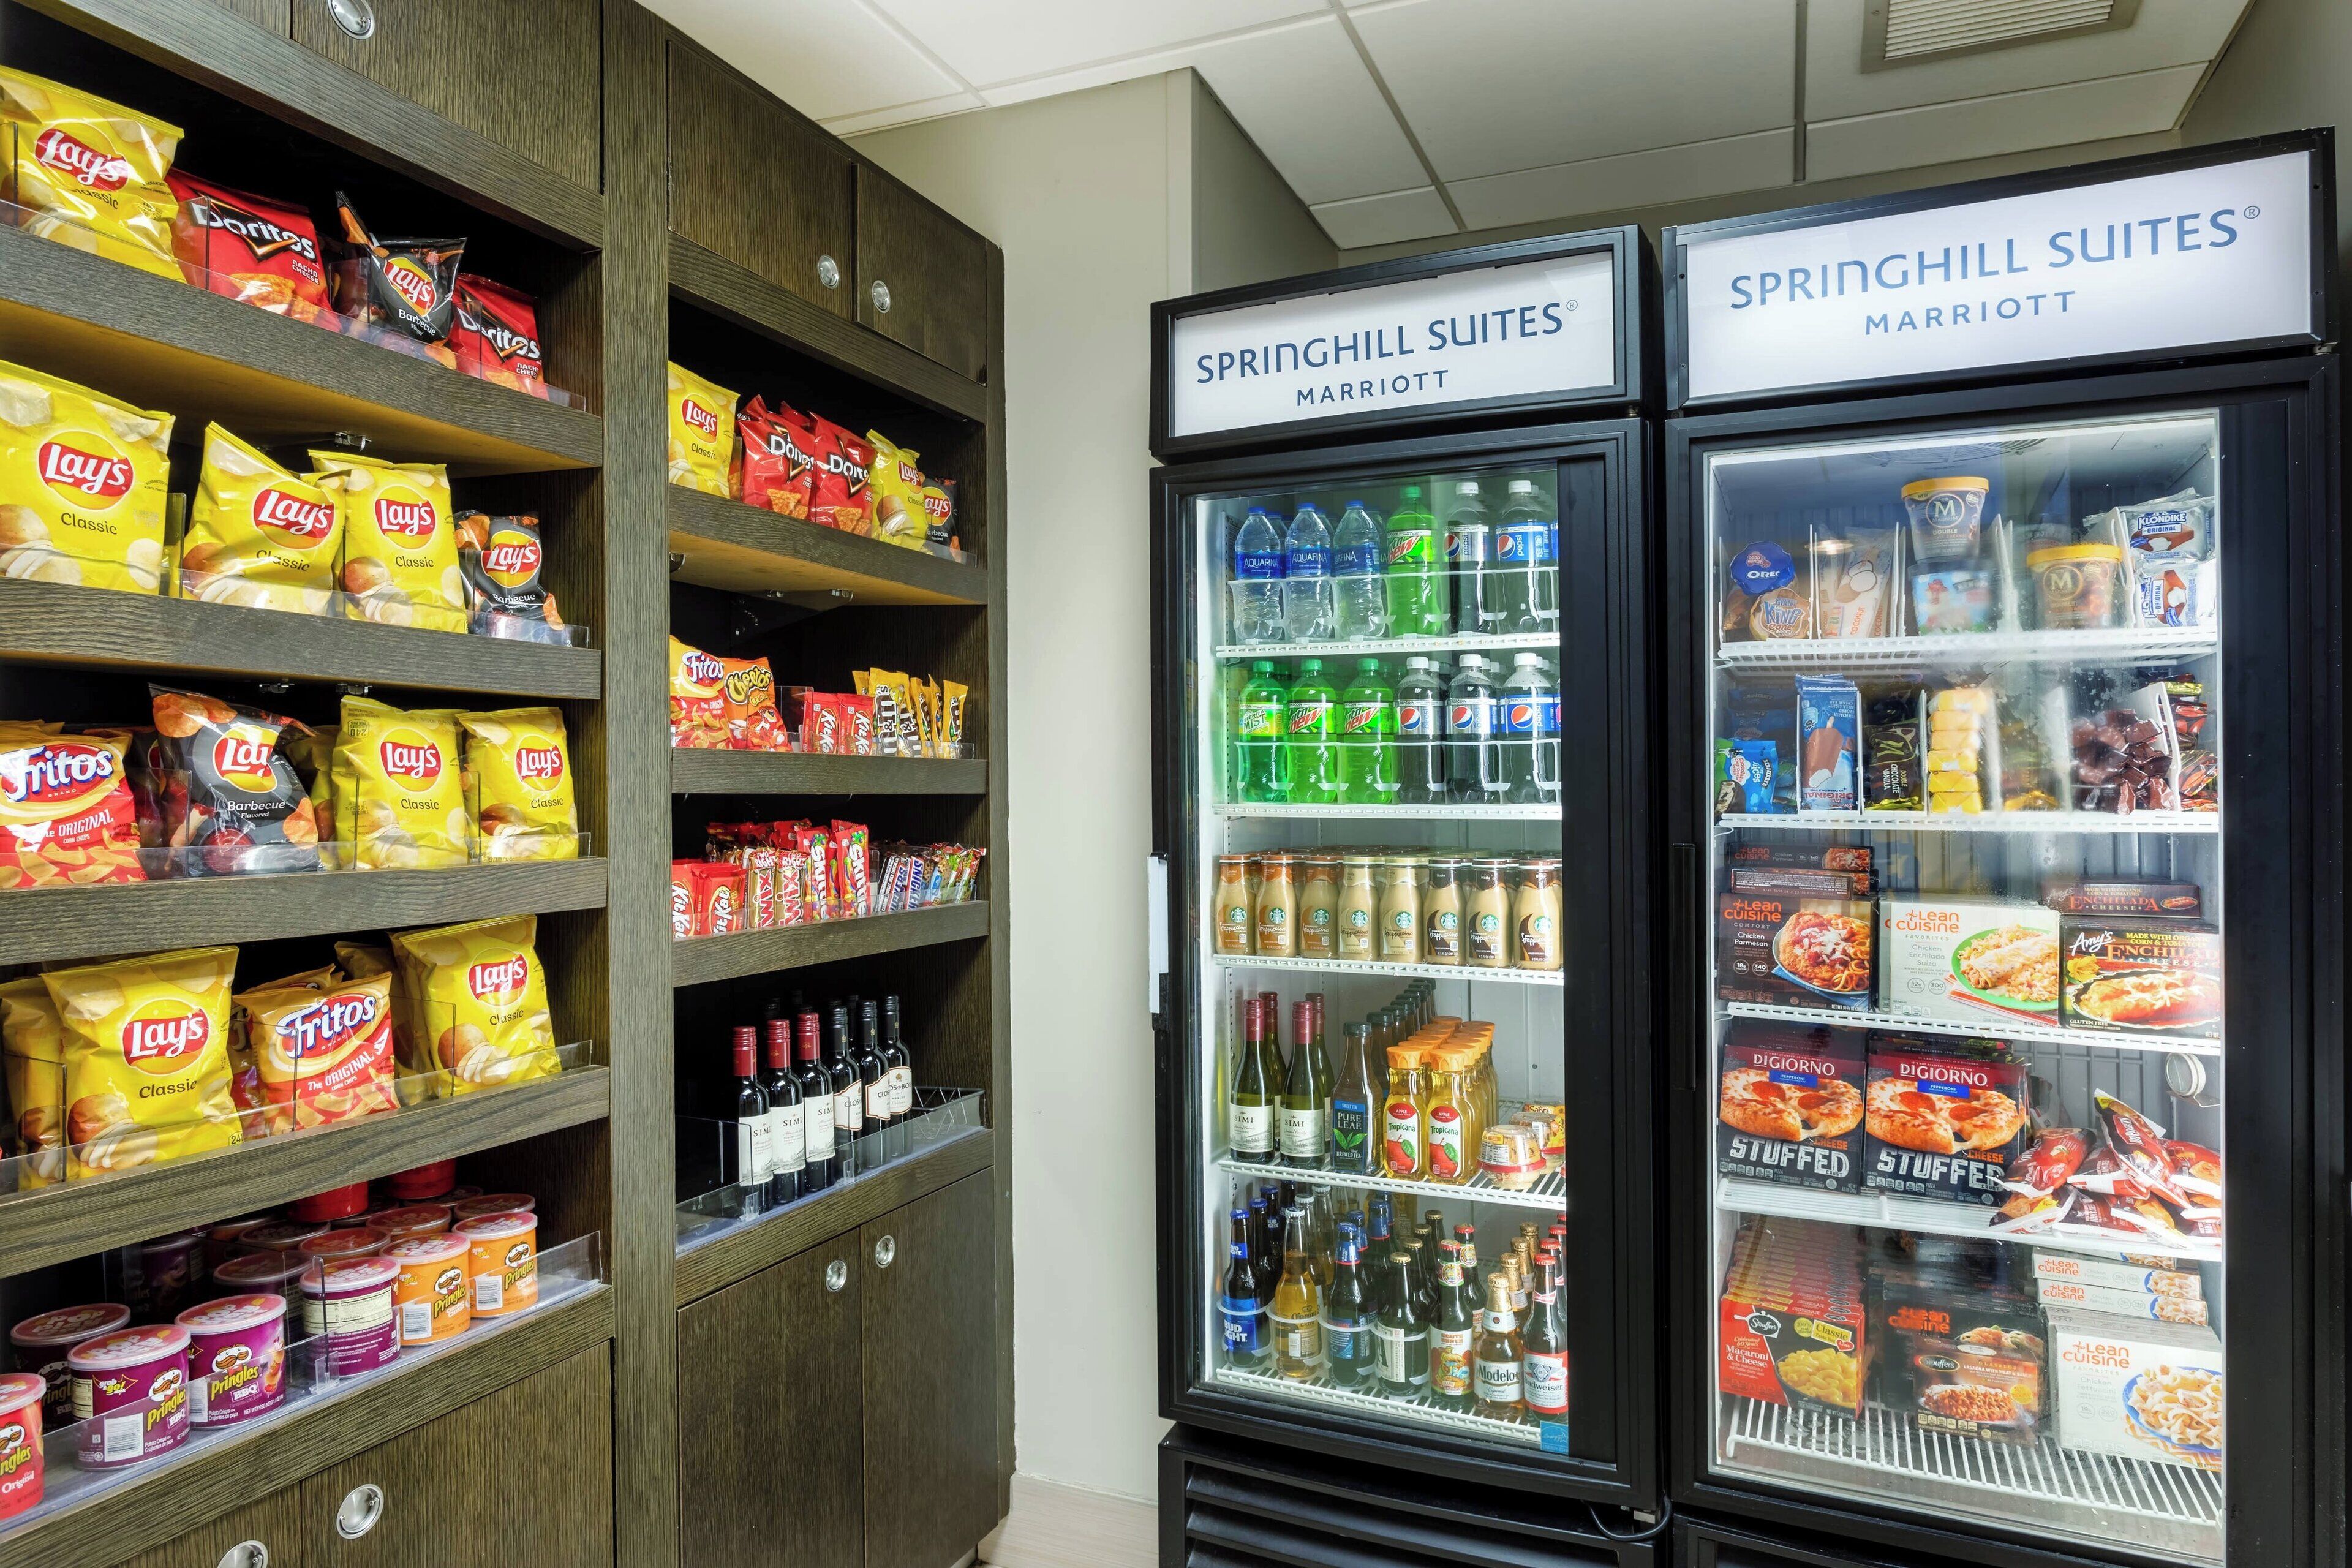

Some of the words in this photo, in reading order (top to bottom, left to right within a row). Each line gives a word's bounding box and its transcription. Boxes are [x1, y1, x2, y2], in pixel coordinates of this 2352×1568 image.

[40, 131, 121, 186] Lay's
[191, 201, 317, 262] Doritos
[292, 258, 318, 278] NACHO
[1730, 238, 2029, 309] SPRINGHILL
[2049, 208, 2239, 268] SUITES
[292, 265, 320, 285] CHEESE
[387, 265, 431, 304] Lay's
[1865, 290, 2076, 335] MARRIOTT
[399, 309, 436, 336] Barbecue
[1197, 325, 1414, 384] SPRINGHILL
[1428, 303, 1563, 351] SUITES
[1297, 369, 1449, 406] MARRIOTT
[685, 401, 717, 432] Lay's
[691, 443, 717, 460] Classic
[45, 445, 129, 494] Lay's
[900, 461, 919, 486] Lay's
[258, 491, 331, 535] Lay's
[380, 499, 432, 537] Lay's
[2138, 511, 2187, 530] KLONDIKE
[61, 512, 118, 535] Classic
[2147, 526, 2177, 534] ORIGINAL
[256, 549, 309, 571] Classic
[395, 556, 434, 568] Classic
[488, 543, 537, 575] Lay's
[1244, 557, 1279, 568] AQUAFINA
[1292, 552, 1327, 563] AQUAFINA
[492, 593, 536, 604] Barbecue
[1776, 598, 1796, 606] GIANT
[2154, 584, 2162, 611] ORIGINAL
[1764, 602, 1801, 625] KING
[1768, 623, 1793, 631] Cone
[728, 666, 772, 701] Cheetos
[1243, 717, 1266, 731] MIST
[1244, 710, 1264, 723] SIERRA
[385, 742, 437, 778] Lay's
[521, 746, 560, 779] Lay's
[1, 745, 115, 802] Fritos
[1899, 769, 1908, 788] DOUBLE
[48, 788, 78, 798] BRAND
[1805, 791, 1854, 800] ORIGINAL
[227, 799, 286, 811] Barbecue
[401, 799, 440, 810] Classic
[530, 797, 564, 809] Classic
[58, 809, 115, 837] ORIGINAL
[1745, 900, 1782, 911] Lean
[2069, 895, 2161, 911] ENCHILADA
[1724, 908, 1782, 922] Cuisine
[1919, 911, 1959, 922] Lean
[1896, 919, 1959, 933] Cuisine
[2070, 930, 2116, 956] Amy's
[2136, 957, 2204, 967] CHEESE
[474, 957, 526, 995] Lay's
[276, 995, 376, 1059] Fritos
[489, 1009, 524, 1026] Classic
[130, 1013, 203, 1058] Lay's
[307, 1080, 323, 1091] The
[325, 1050, 375, 1088] ORIGINAL
[1753, 1054, 1835, 1076] DIGIORNO
[1900, 1063, 1988, 1087] DIGIORNO
[139, 1079, 197, 1099] Classic
[783, 1117, 802, 1127] SIMI
[1338, 1112, 1362, 1122] PURE
[1388, 1122, 1415, 1133] Tropicana
[1430, 1125, 1458, 1136] Tropicana
[1814, 1137, 1849, 1150] CHEESE
[1729, 1134, 1850, 1178] STUFFED
[1969, 1149, 2004, 1164] CHEESE
[1876, 1147, 2005, 1189] STUFFED
[1981, 1183, 1999, 1191] CRUST
[2038, 1264, 2079, 1276] Cuisine
[2052, 1259, 2079, 1268] Lean
[505, 1260, 534, 1291] Pringles
[2043, 1289, 2084, 1301] Cuisine
[2058, 1285, 2084, 1294] Lean
[434, 1285, 466, 1318] Pringles
[1751, 1317, 1777, 1331] Stouffer's
[1815, 1324, 1849, 1341] Classic
[1725, 1344, 1769, 1360] Macaroni
[2062, 1350, 2130, 1369] Cuisine
[2086, 1343, 2130, 1358] Lean
[1735, 1355, 1768, 1368] Cheese
[1978, 1360, 2017, 1370] CLASSICS
[1479, 1363, 1515, 1381] Modelo
[2081, 1376, 2113, 1386] Chicken
[211, 1365, 258, 1401] Pringles
[233, 1384, 258, 1400] BBQ
[147, 1388, 186, 1431] Pringles
[169, 1408, 186, 1427] BBQ
[2, 1471, 35, 1493] Original
